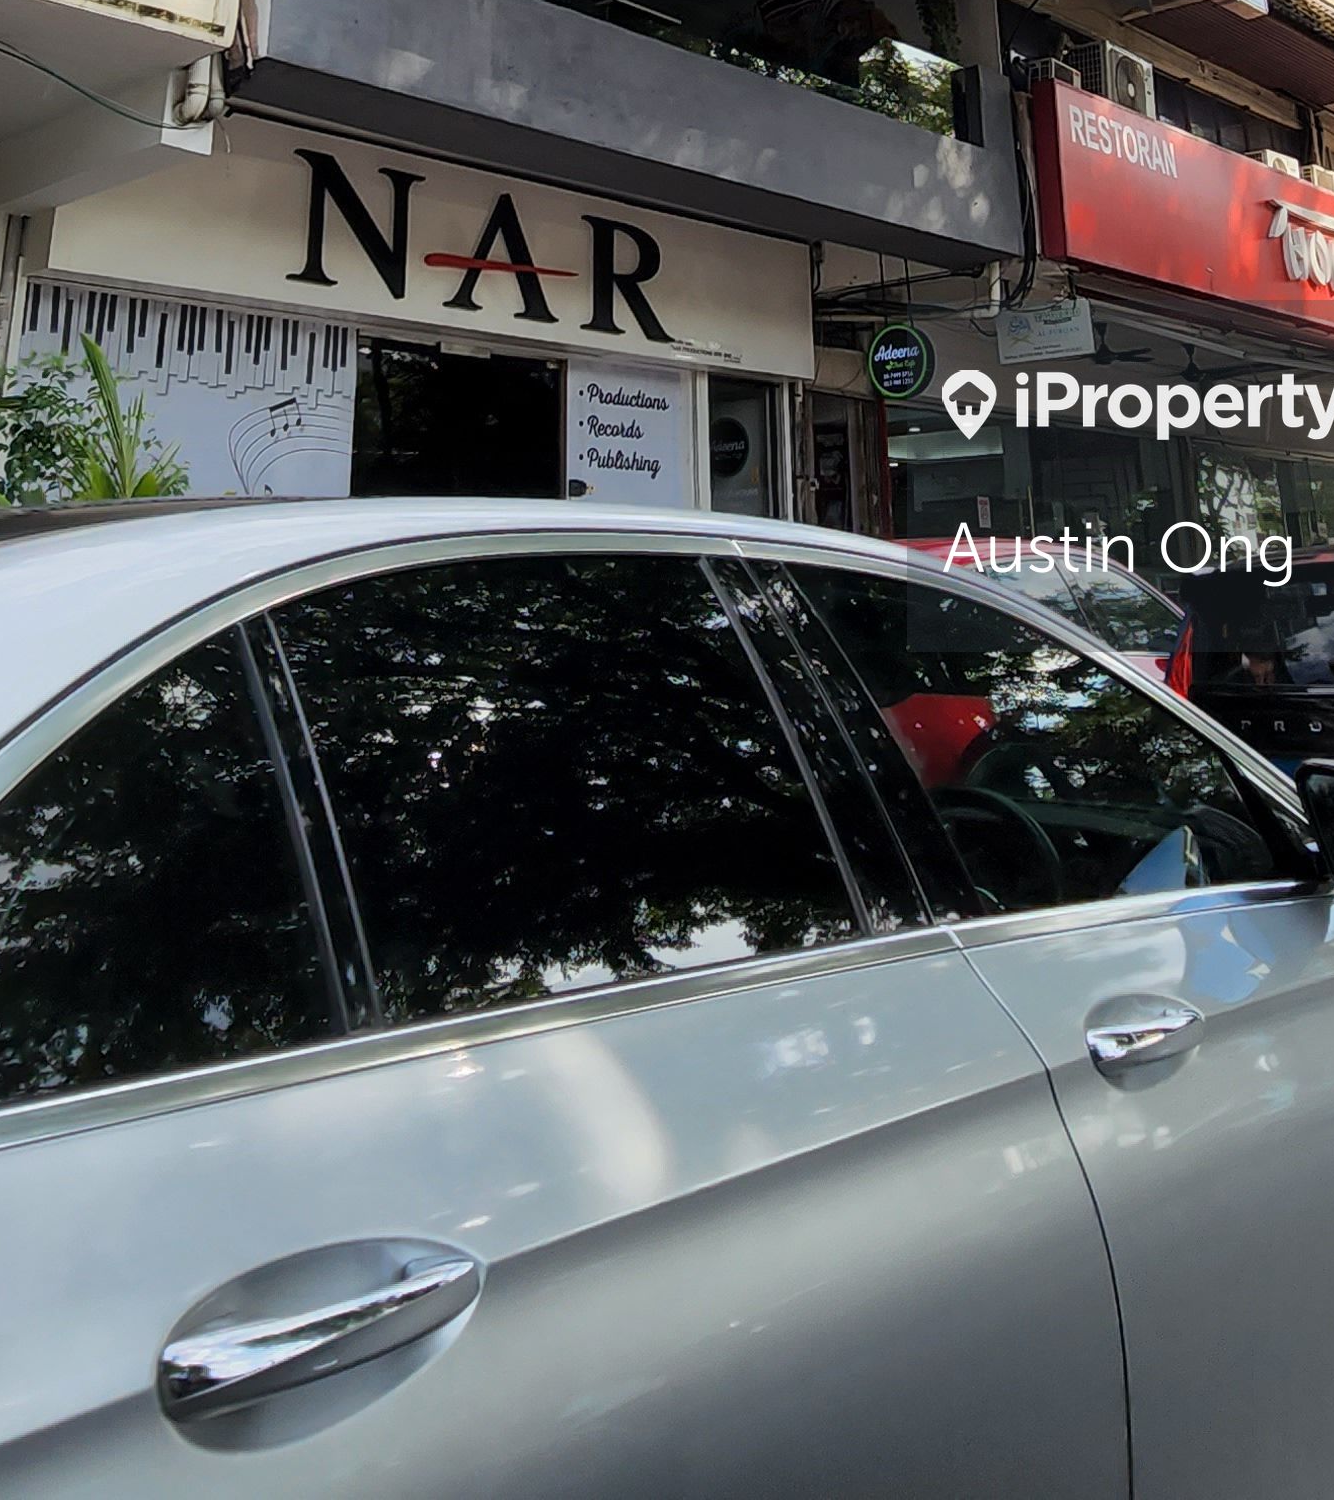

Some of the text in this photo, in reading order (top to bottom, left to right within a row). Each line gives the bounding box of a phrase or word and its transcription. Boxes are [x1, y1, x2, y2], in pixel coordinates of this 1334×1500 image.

[1069, 104, 1178, 179] RESTORAN
[285, 148, 677, 343] NAR
[874, 344, 920, 362] Adeena
[587, 383, 670, 411] Productions
[587, 415, 644, 439] Records
[587, 447, 661, 480] Publishing
